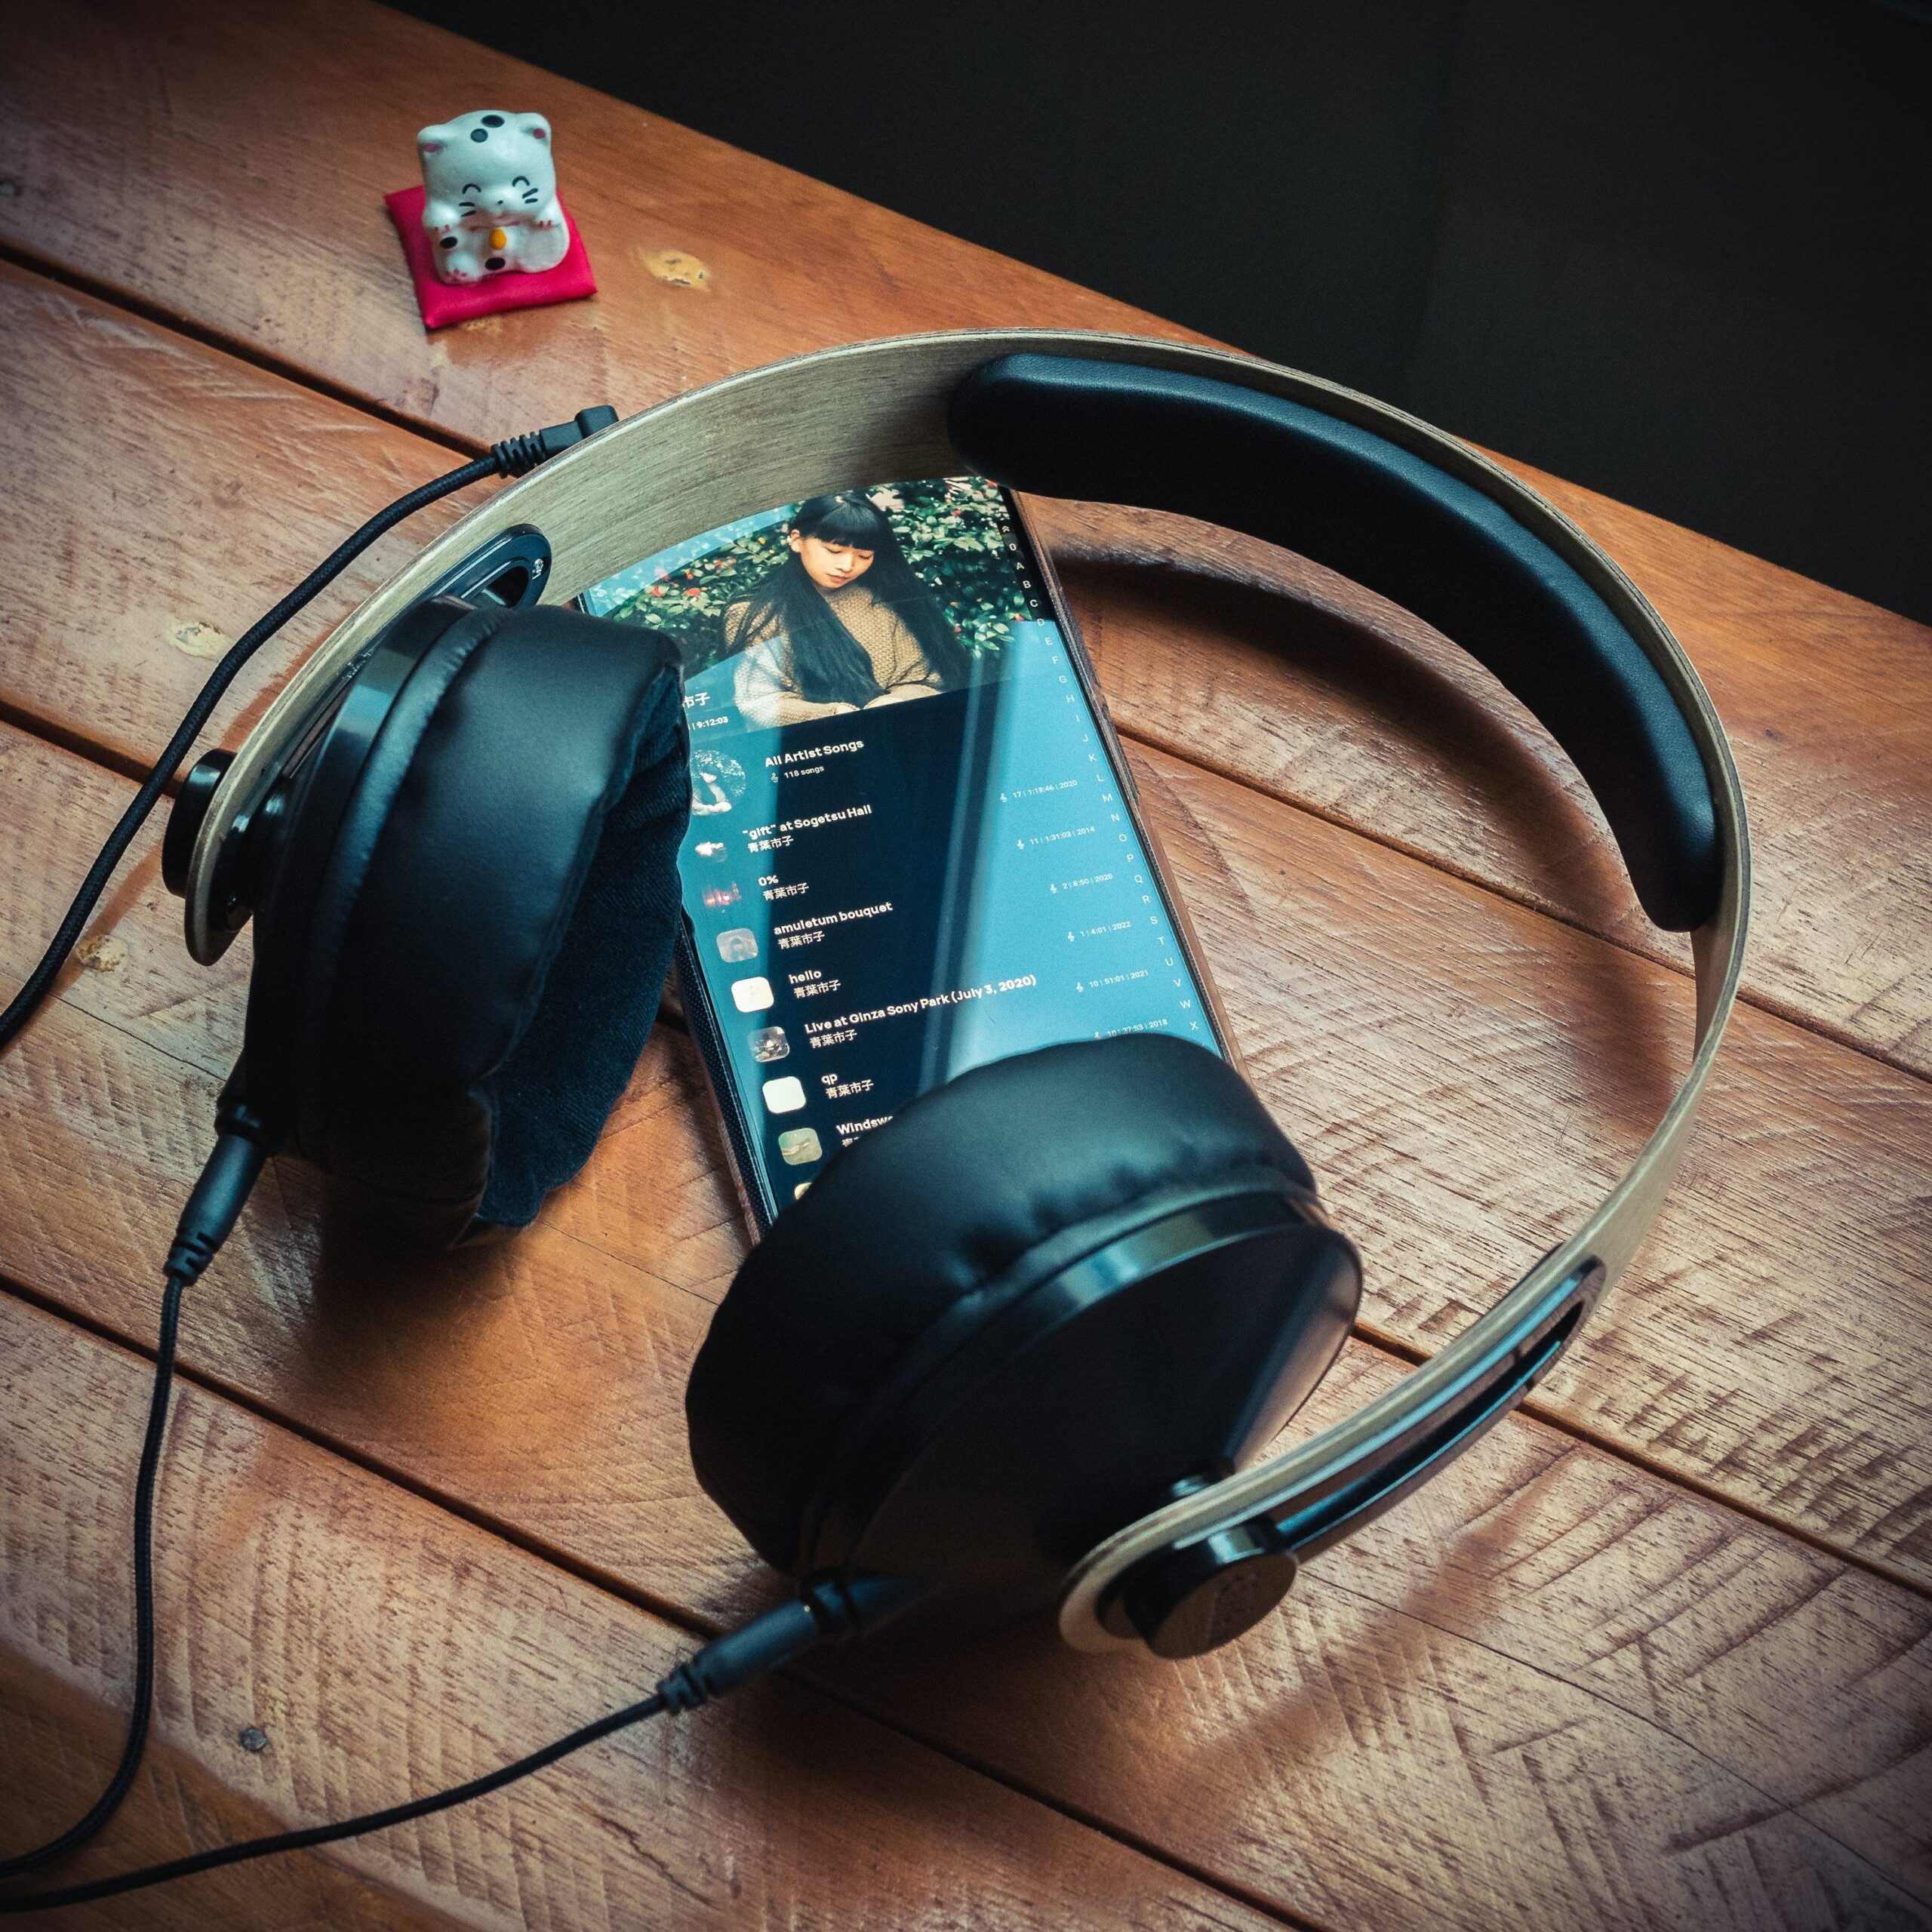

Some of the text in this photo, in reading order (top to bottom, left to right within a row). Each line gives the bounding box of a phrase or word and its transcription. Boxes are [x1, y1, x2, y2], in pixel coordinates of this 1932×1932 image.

[1023, 580, 1031, 589] B
[1029, 599, 1038, 608] C
[1037, 618, 1045, 626] D
[1044, 637, 1053, 645] E
[1052, 656, 1060, 664] F
[1066, 694, 1075, 703] H
[697, 716, 729, 728] 9:12:03
[1082, 734, 1089, 743] J
[765, 740, 864, 768] All Artist Songs
[784, 766, 824, 778] 118 songs
[1059, 780, 1078, 789] 2020
[1102, 793, 1113, 802] M
[780, 821, 793, 832] at
[794, 811, 847, 829] Sogetsu
[846, 804, 872, 818] Hall
[1111, 813, 1120, 822] N
[1044, 831, 1072, 841] 1:31:03
[1076, 826, 1095, 835] 2014
[1118, 833, 1127, 842] O
[747, 835, 794, 853] 青葉市子
[1126, 854, 1134, 863] P
[758, 875, 779, 886] 0%
[1094, 873, 1113, 882] 2020
[1134, 875, 1143, 883] Q
[763, 882, 809, 901] 青葉市子
[1142, 895, 1151, 903] R
[774, 902, 893, 935] amuletum bouquet
[1149, 915, 1158, 924] S
[1091, 926, 1106, 934] 4:01
[1112, 921, 1131, 931] 2022
[778, 931, 825, 949] 青葉市子
[1157, 936, 1165, 945] T
[1164, 957, 1174, 967] U
[789, 970, 822, 984] hello
[1104, 975, 1124, 984] 51:01
[1130, 970, 1149, 979] 2021
[1173, 979, 1183, 987] V
[793, 979, 841, 998] 青葉市子
[804, 1021, 832, 1034] Live
[834, 1017, 848, 1027] at
[849, 1010, 886, 1023] Ginza
[887, 1001, 918, 1015] Sony
[919, 994, 950, 1009] Park
[951, 988, 983, 1003] (July
[998, 974, 1036, 992] 2020)
[1180, 999, 1190, 1009] W
[1149, 1018, 1168, 1028] 2018
[1189, 1021, 1198, 1030] X
[810, 1029, 857, 1048] 青葉市子
[821, 1074, 838, 1085] qp
[826, 1079, 874, 1099] 青葉市子
